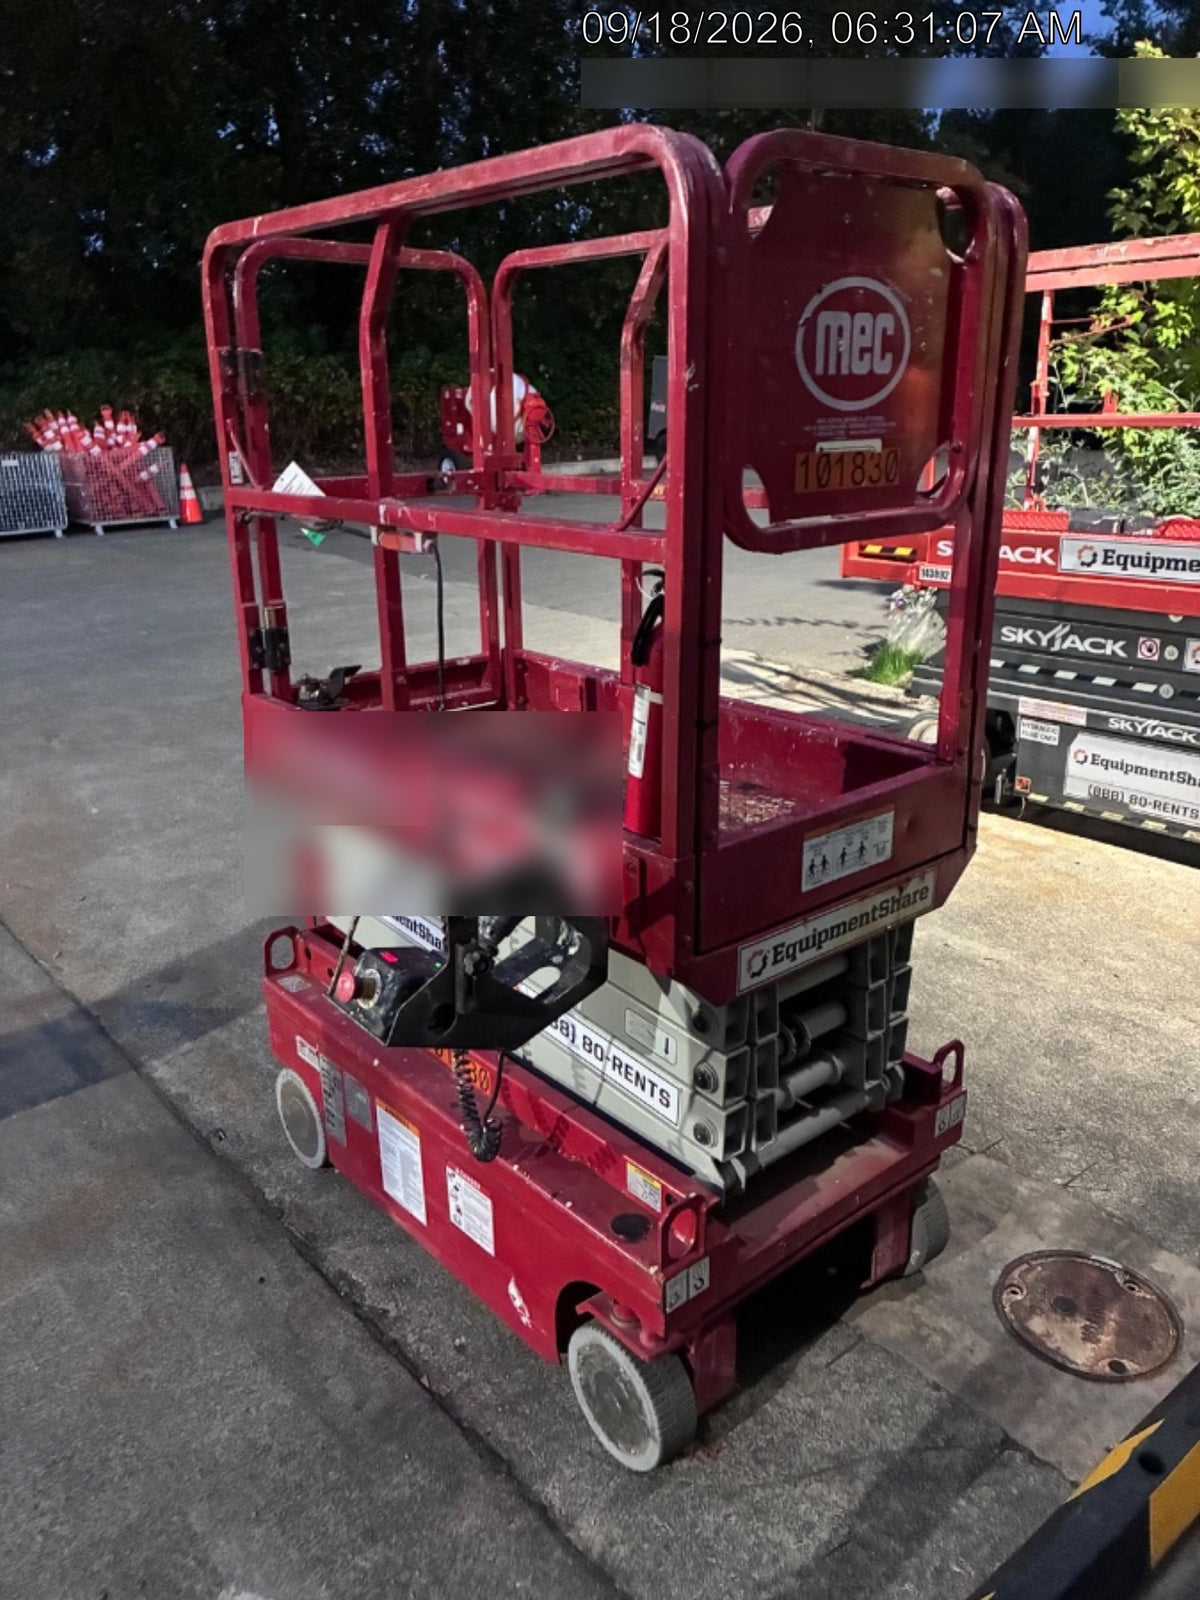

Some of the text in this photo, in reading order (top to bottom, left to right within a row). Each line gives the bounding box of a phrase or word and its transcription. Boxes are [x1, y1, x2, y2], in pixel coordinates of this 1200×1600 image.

[801, 449, 898, 490] 101830
[937, 540, 1056, 566] SACK
[1000, 624, 1128, 658] SKYJACK
[1108, 717, 1198, 743] SKYJACK
[1129, 794, 1199, 819] 80-RENTS
[771, 885, 929, 964] EquipmentShare
[582, 1034, 671, 1109] 80-RENTS
